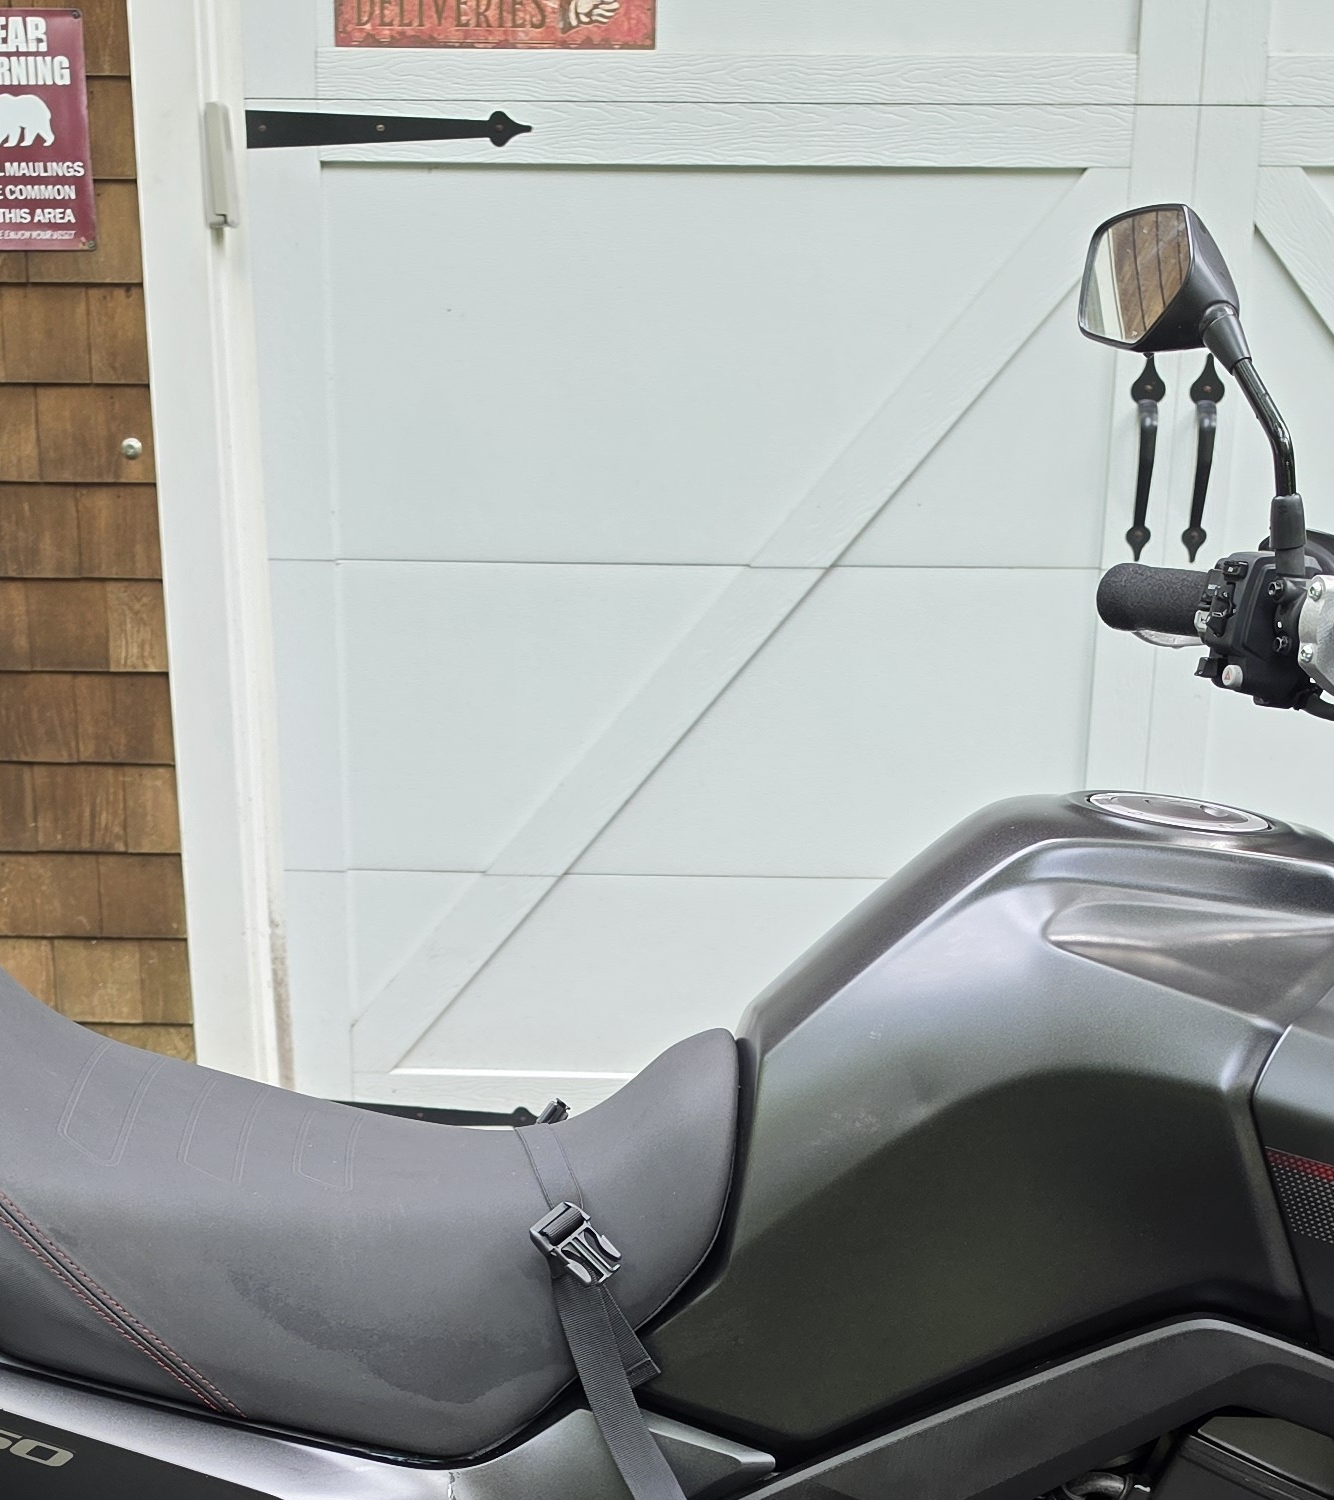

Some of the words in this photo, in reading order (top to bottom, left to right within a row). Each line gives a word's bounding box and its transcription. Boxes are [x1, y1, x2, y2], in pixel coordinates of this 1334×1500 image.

[5, 162, 84, 176] MAULINGS
[5, 185, 76, 199] COMMON
[33, 209, 76, 223] AREA
